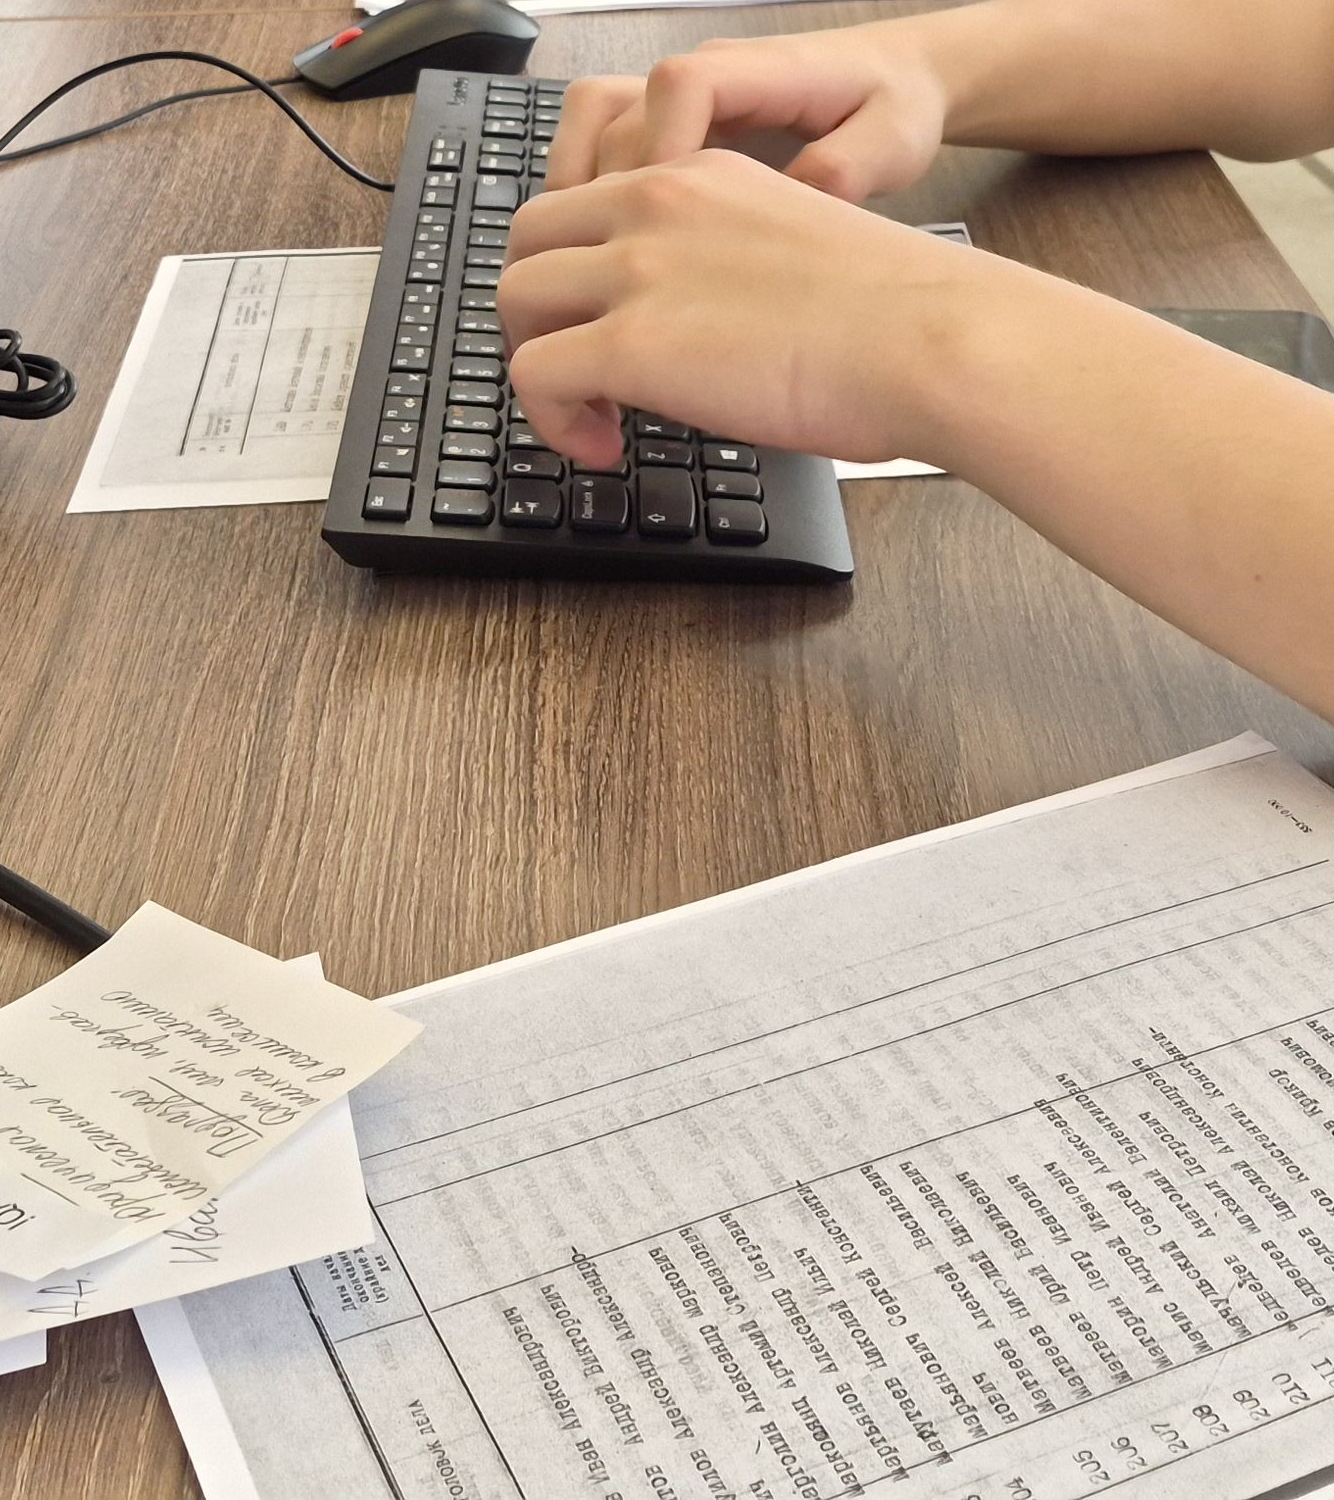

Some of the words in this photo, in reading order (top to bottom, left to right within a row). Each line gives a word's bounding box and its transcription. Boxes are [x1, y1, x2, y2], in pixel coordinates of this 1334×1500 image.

[1268, 1068, 1324, 1119] Крикор
[1137, 1110, 1207, 1178] Петрович
[859, 1164, 935, 1251] Васильевич
[898, 1160, 975, 1248] Николаевич
[951, 1170, 1035, 1262] Васильевич
[1004, 1173, 1073, 1246] Иванович
[1042, 1161, 1111, 1234] Иванович
[1105, 1179, 1162, 1237] Сергей
[1142, 1167, 1217, 1239] Анатолий
[1229, 1159, 1298, 1223] Николай
[319, 1254, 342, 1281] нача
[335, 1284, 358, 1313] Даты
[647, 1246, 704, 1319] Маркович
[677, 1225, 749, 1316] Степанович
[788, 1247, 836, 1297] Ильич
[854, 1266, 908, 1328] Сергей
[933, 1261, 997, 1331] Алексей
[967, 1249, 1032, 1320] Николай
[1027, 1263, 1072, 1306] Юрий
[1069, 1250, 1110, 1292] Петр
[1104, 1234, 1165, 1294] Андрей
[537, 1283, 605, 1380] Викторович
[737, 1318, 797, 1390] Артемий
[771, 1287, 840, 1374] Александр
[826, 1299, 888, 1372] Николай
[1028, 1324, 1093, 1401] Матвеев
[1068, 1310, 1134, 1386] Матвеев
[1106, 1295, 1174, 1370] Маторин
[1162, 1301, 1214, 1356] Мачис
[499, 1306, 583, 1431] Александрович
[629, 1347, 695, 1440] Александр
[698, 1324, 766, 1414] Александр
[904, 1332, 989, 1439] Марьянович
[971, 1371, 1020, 1425] нович
[993, 1337, 1057, 1415] Матвеев
[404, 1398, 437, 1436] ДЕЛА
[593, 1380, 645, 1446] Андрей
[835, 1381, 917, 1484] Мартьянов
[425, 1438, 464, 1500] ОЛОВОК
[574, 1437, 611, 1486] Иван
[759, 1420, 823, 1500] арголин
[1003, 1475, 1033, 1500] 04
